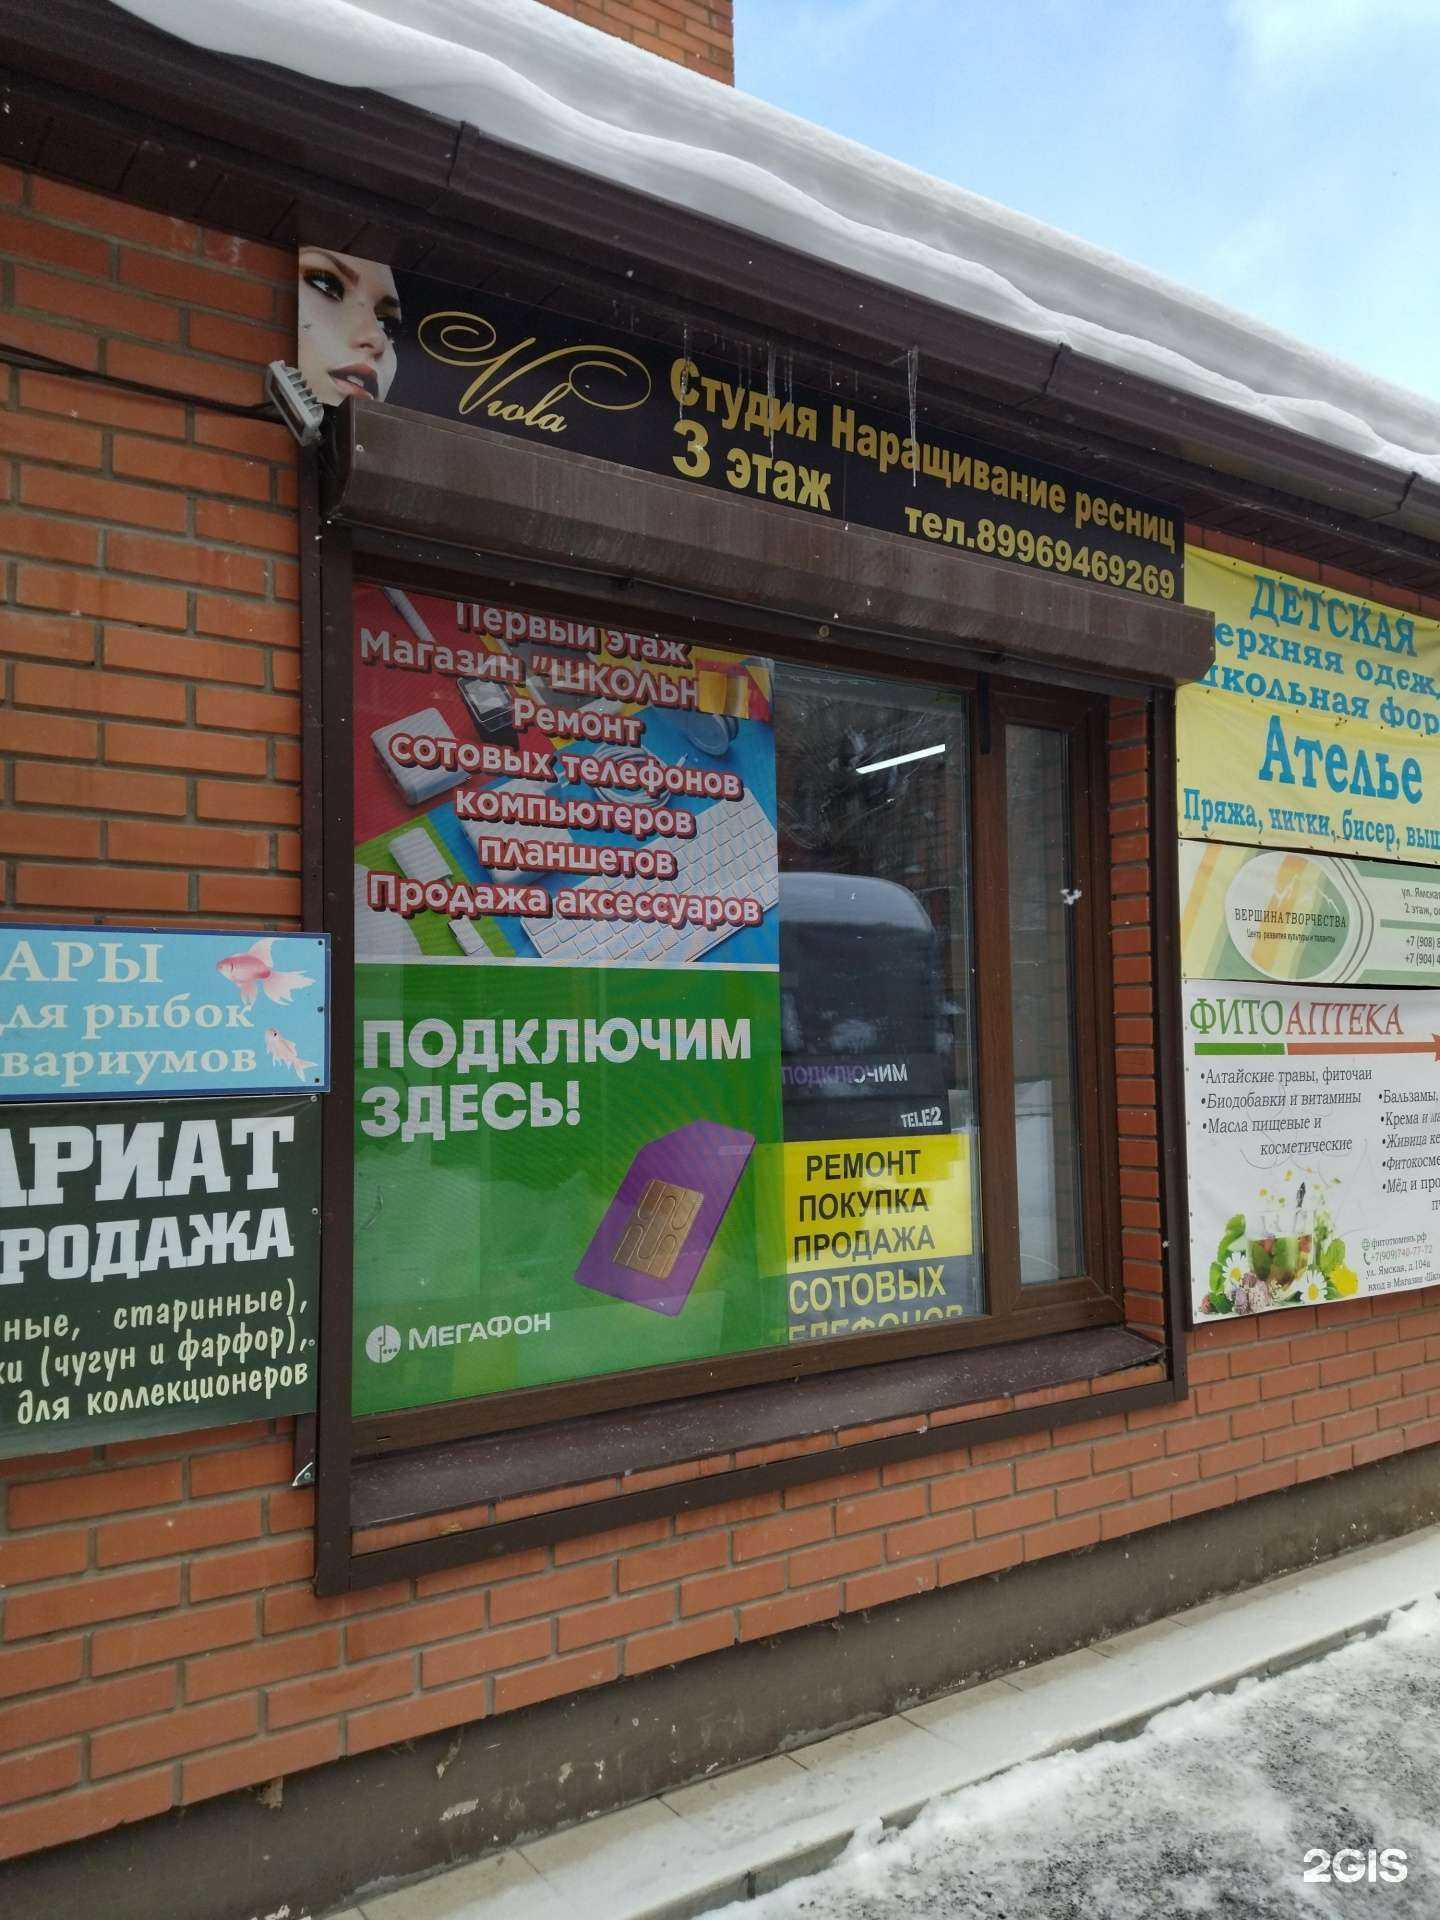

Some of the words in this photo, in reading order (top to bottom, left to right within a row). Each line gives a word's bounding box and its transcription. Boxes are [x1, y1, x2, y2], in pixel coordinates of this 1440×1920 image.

[418, 311, 651, 433] Viola
[671, 358, 817, 442] Студия
[831, 405, 1066, 513] Наращивание
[1075, 491, 1175, 553] ресниц
[672, 419, 711, 478] 3
[726, 448, 832, 512] этаж
[904, 505, 1175, 599] тел.89969469269
[1250, 575, 1418, 657] ДЕТСКАЯ
[360, 628, 520, 681] Магазин
[607, 630, 687, 662] этаж
[1214, 622, 1344, 675] ерхняя
[1355, 659, 1440, 698] одеж
[513, 699, 641, 742] Ремонт
[391, 736, 554, 776] сотовых
[561, 753, 740, 797] телефонов
[1258, 715, 1423, 804] Ателье
[456, 791, 693, 836] компьютеров
[1183, 788, 1263, 834] Пряжа,
[1269, 807, 1336, 843] нитки,
[1343, 808, 1400, 852] бисер,
[480, 839, 673, 876] планшетов
[369, 874, 547, 916] Продажа
[557, 895, 760, 927] аксессуаров
[1234, 908, 1284, 924] ВЕРШИНА
[1285, 911, 1347, 928] ТВОРЧЕСТВА
[0, 940, 164, 983] АРЫ
[0, 993, 68, 1037] ля
[81, 993, 255, 1039] рыбок
[363, 1017, 752, 1073] ПОДКЛЮЧИМ
[0, 1050, 257, 1087] вариумов
[1206, 1068, 1275, 1084] Алтайские
[1278, 1070, 1319, 1086] травы,
[1322, 1066, 1372, 1085] фиточаи
[361, 1081, 581, 1142] ЗДЕСЬ!
[901, 1107, 943, 1128] TELE2
[1207, 1091, 1286, 1110] Биодобавки
[1289, 1095, 1298, 1106] и
[1301, 1092, 1362, 1106] витамины
[1385, 1111, 1419, 1129] Крема
[1422, 1113, 1428, 1123] и
[1208, 1118, 1248, 1134] Масла
[1251, 1118, 1310, 1132] пищевые
[1314, 1117, 1322, 1128] и
[1260, 1138, 1352, 1155] косметические
[806, 1149, 921, 1181] РЕМОНТ
[1410, 1180, 1417, 1191] и
[799, 1187, 930, 1222] ПОКУПКА
[794, 1225, 936, 1263] ПРОДАЖА
[4, 1313, 80, 1342] ные,
[113, 1278, 307, 1332] старинные),
[789, 1264, 946, 1315] СОТОВЫХ
[41, 1346, 135, 1387] (чугун
[150, 1344, 164, 1365] и
[178, 1316, 307, 1371] фарфор),
[18, 1389, 70, 1425] для
[87, 1363, 308, 1416] коллекционеров
